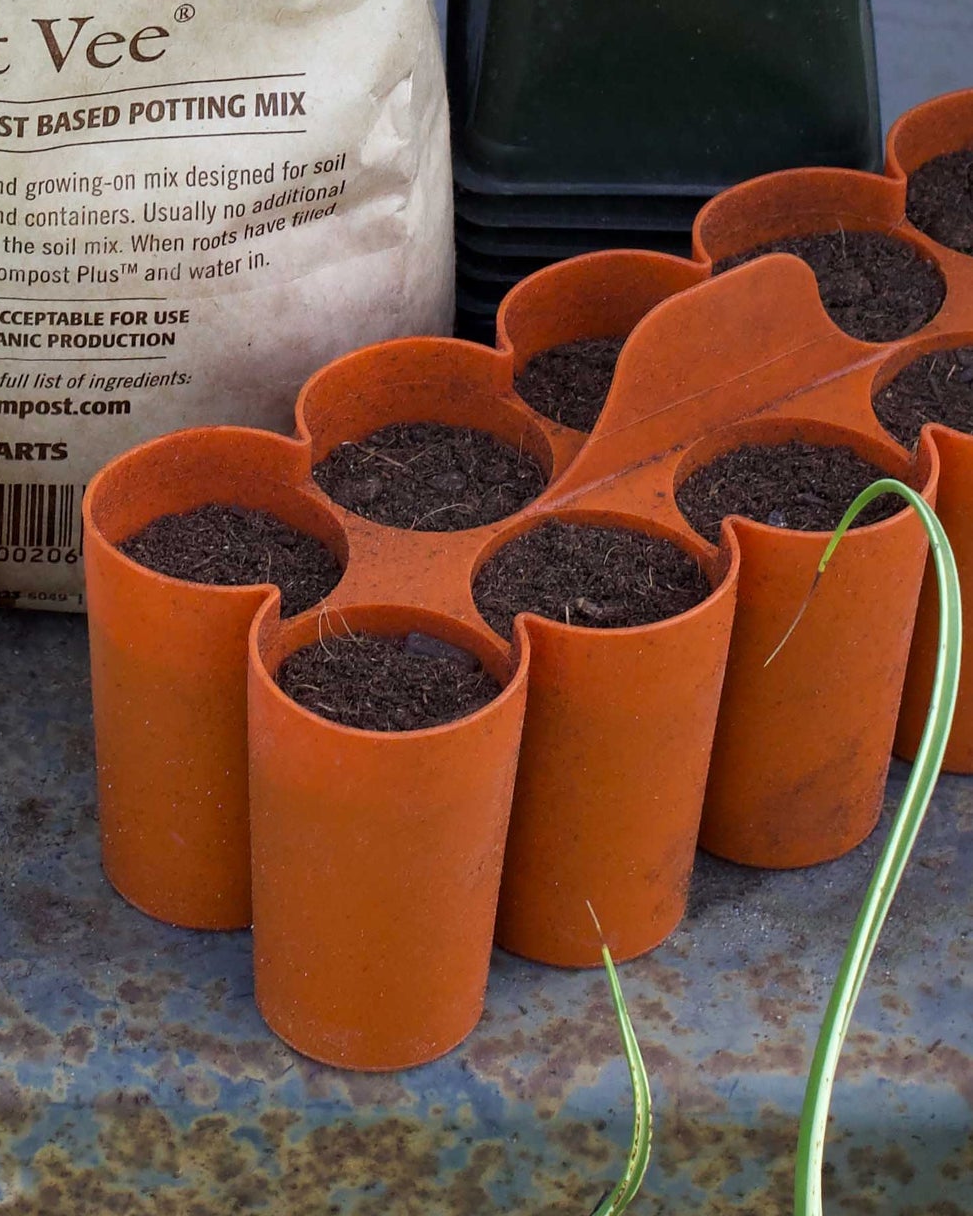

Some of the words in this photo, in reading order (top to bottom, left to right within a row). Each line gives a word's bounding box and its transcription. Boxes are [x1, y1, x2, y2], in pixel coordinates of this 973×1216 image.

[37, 105, 120, 136] BASED
[129, 93, 245, 125] POTTING
[255, 91, 307, 117] MIX
[25, 171, 136, 200] growing-on
[144, 166, 178, 189] mix
[186, 162, 274, 190] designed
[282, 160, 308, 181] for
[313, 153, 346, 175] soil
[25, 205, 136, 227] containers.
[143, 200, 217, 224] Usually
[223, 202, 246, 220] no
[252, 180, 346, 214] additional
[3, 235, 35, 255] the
[42, 237, 76, 256] soil
[85, 236, 123, 255] mix.
[131, 233, 184, 253] When
[192, 230, 237, 251] roots
[244, 217, 285, 240] have
[292, 202, 336, 227] filled
[144, 260, 181, 282] and
[189, 258, 242, 280] water
[248, 250, 270, 270] in.
[110, 311, 148, 326] FOR
[154, 309, 190, 324] USE
[47, 332, 176, 348] PRODUCTION
[0, 372, 29, 389] full
[34, 373, 61, 389] list
[66, 374, 86, 389] of
[90, 371, 192, 392] ingredients:
